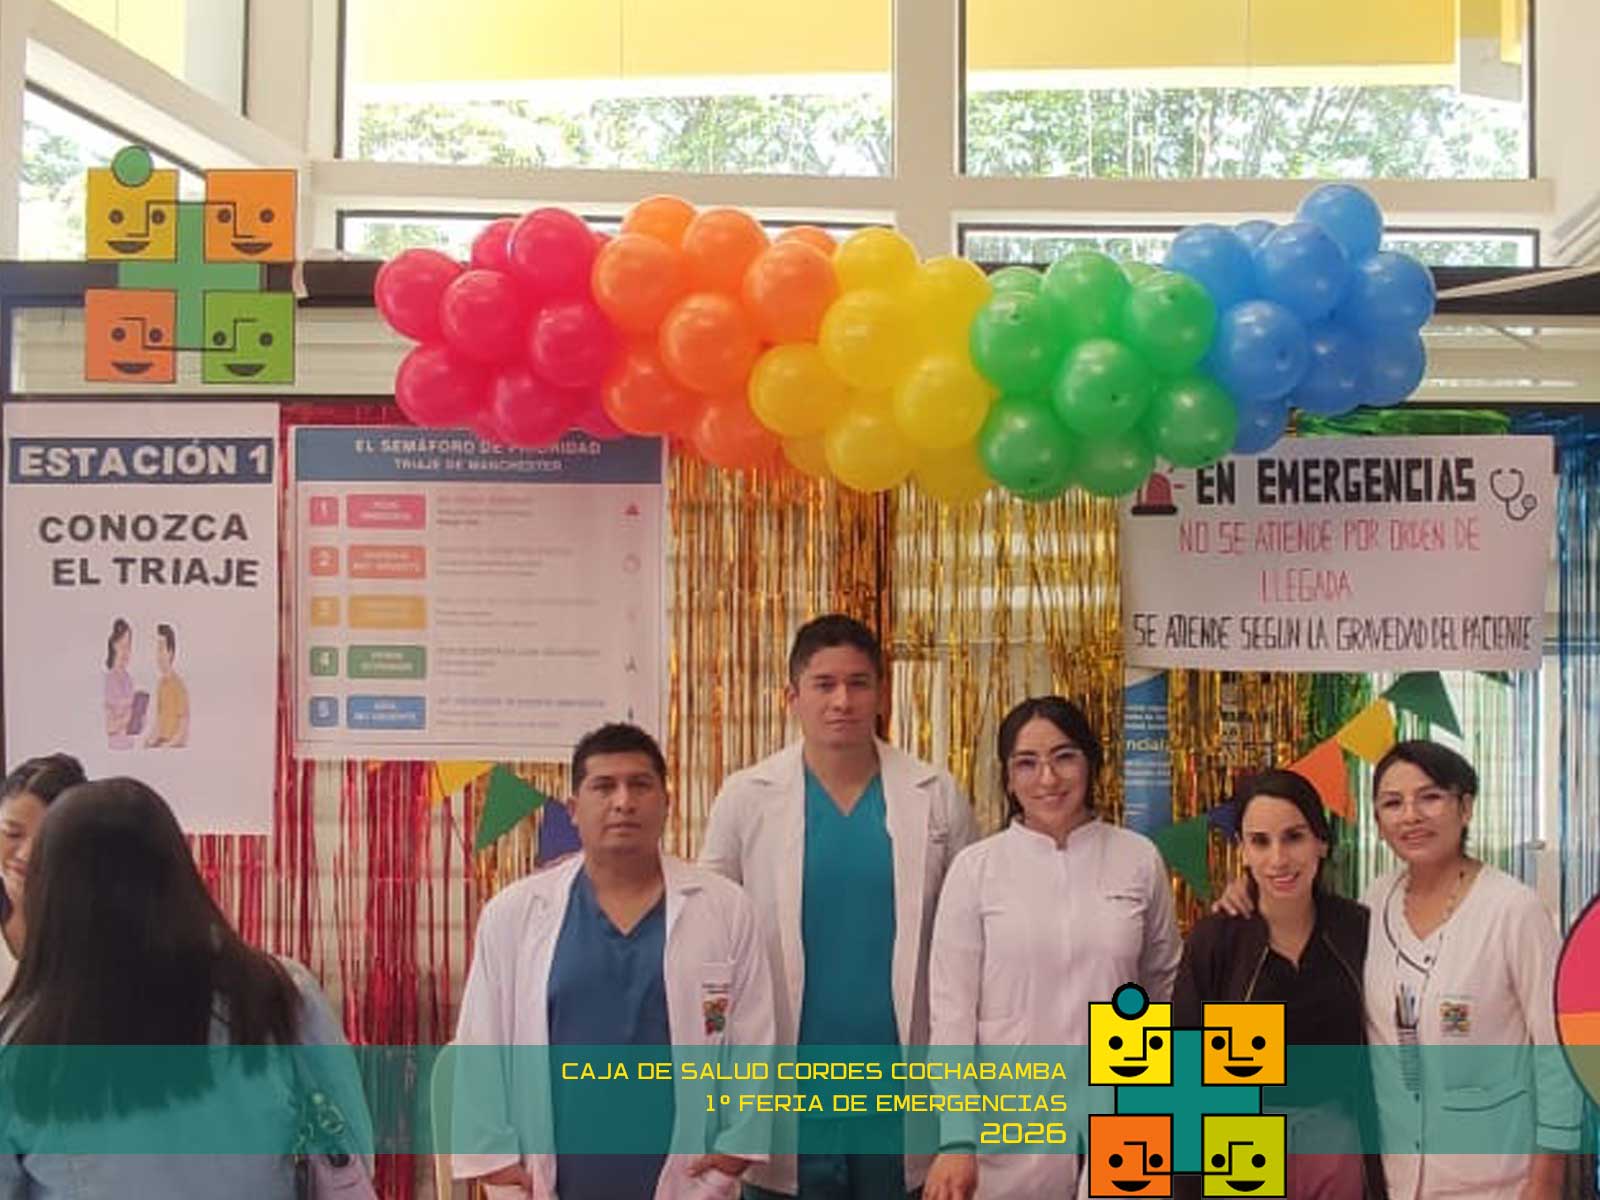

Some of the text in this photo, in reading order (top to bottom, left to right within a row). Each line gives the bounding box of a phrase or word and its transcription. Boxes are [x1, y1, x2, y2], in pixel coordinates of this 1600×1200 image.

[18, 439, 269, 477] ESTACIÓN 1
[355, 438, 374, 452] EL
[381, 435, 475, 454] SEMÁFORO
[1196, 457, 1476, 505] EN EMERGENCIAS
[39, 513, 248, 543] CONOZCA
[1178, 516, 1481, 555] NO SE ATIENDE POR ORDEN DE
[52, 556, 259, 587] EL TRIAJE
[1259, 568, 1351, 602] LLEGADA
[1133, 613, 1159, 647] SE
[1165, 613, 1234, 650] ATIENDE
[1308, 616, 1329, 650] LA
[1336, 616, 1429, 651] GRAVEDAD
[1431, 616, 1456, 650] DEL
[1462, 615, 1532, 650] PACIENTE
